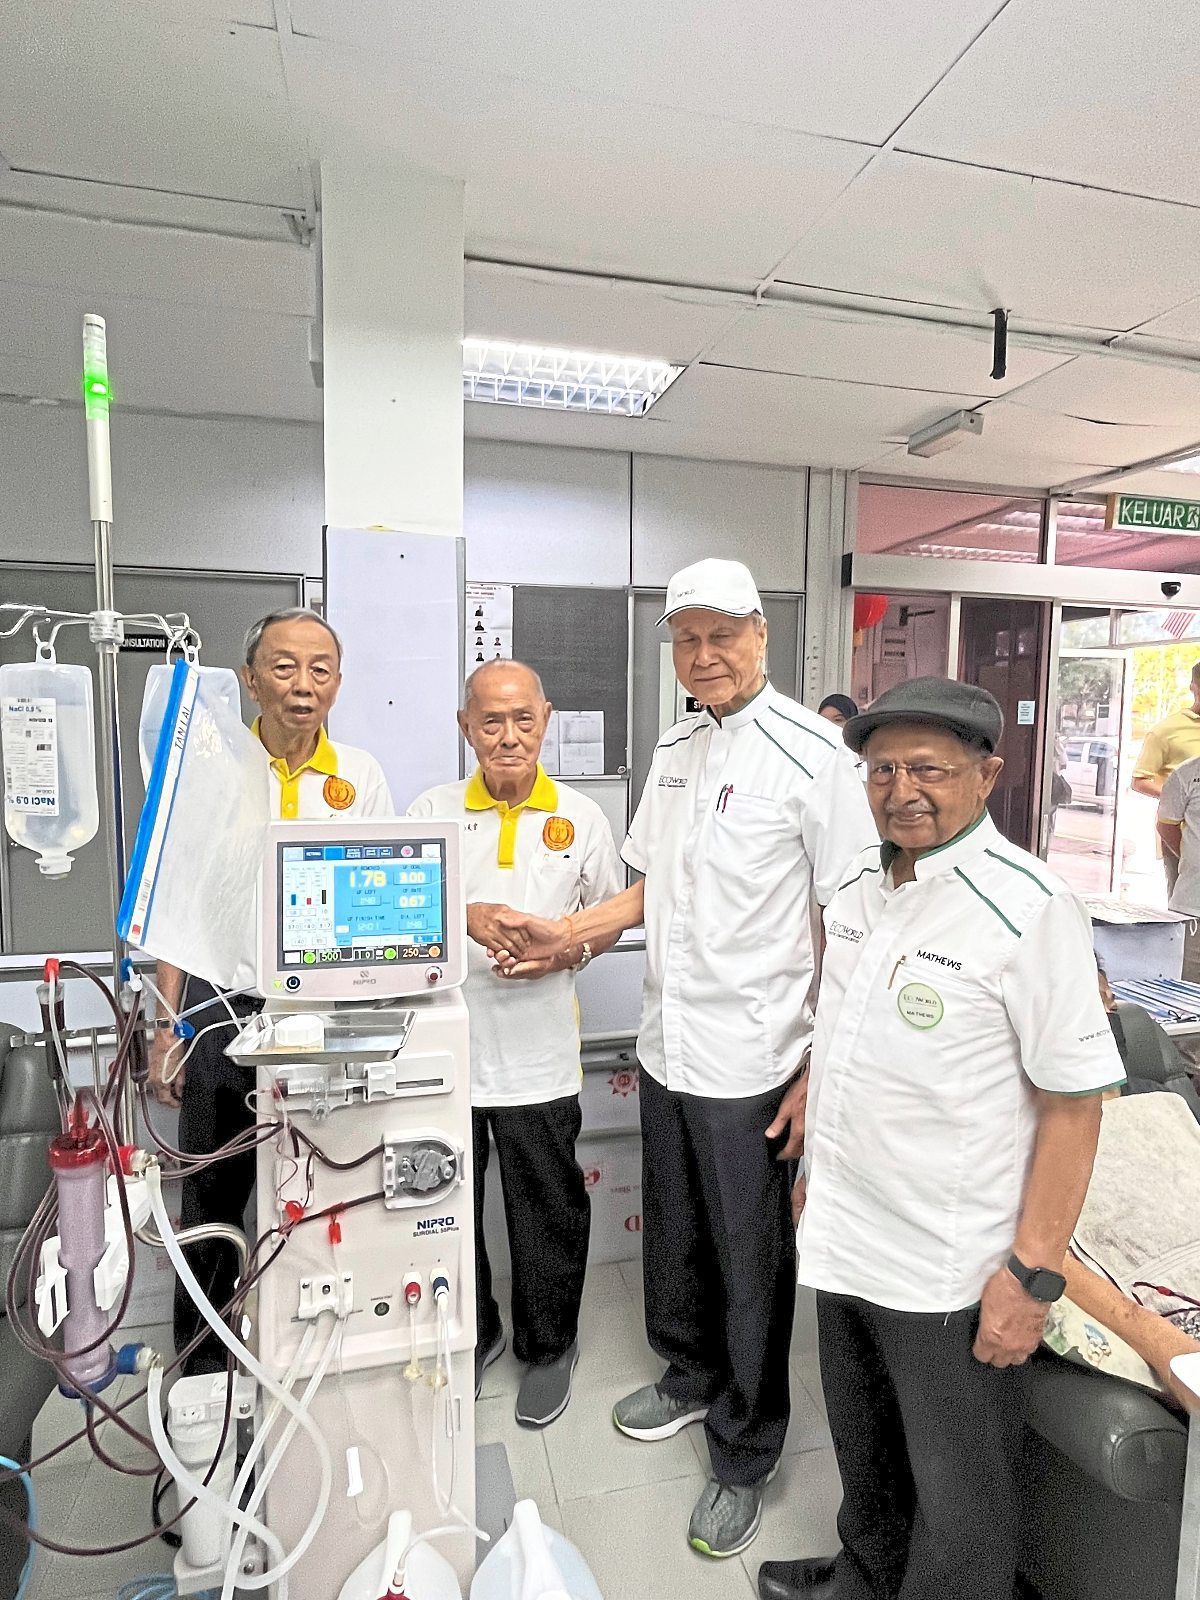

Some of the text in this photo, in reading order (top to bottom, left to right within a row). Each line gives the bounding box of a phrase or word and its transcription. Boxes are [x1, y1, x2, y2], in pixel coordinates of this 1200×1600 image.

[1121, 499, 1185, 527] KELUAR
[121, 638, 165, 648] ONSULTATION
[16, 795, 29, 805] 0.9
[31, 796, 56, 806] NaCl
[349, 870, 387, 888] 1.78
[829, 920, 864, 939] ECOWORLD
[321, 952, 339, 961] 500
[402, 949, 419, 958] 250
[916, 949, 963, 971] MATHEWS
[906, 1010, 935, 1019] MATHEWS
[416, 1216, 455, 1230] NIPRO
[412, 1228, 439, 1237] SURDIAL
